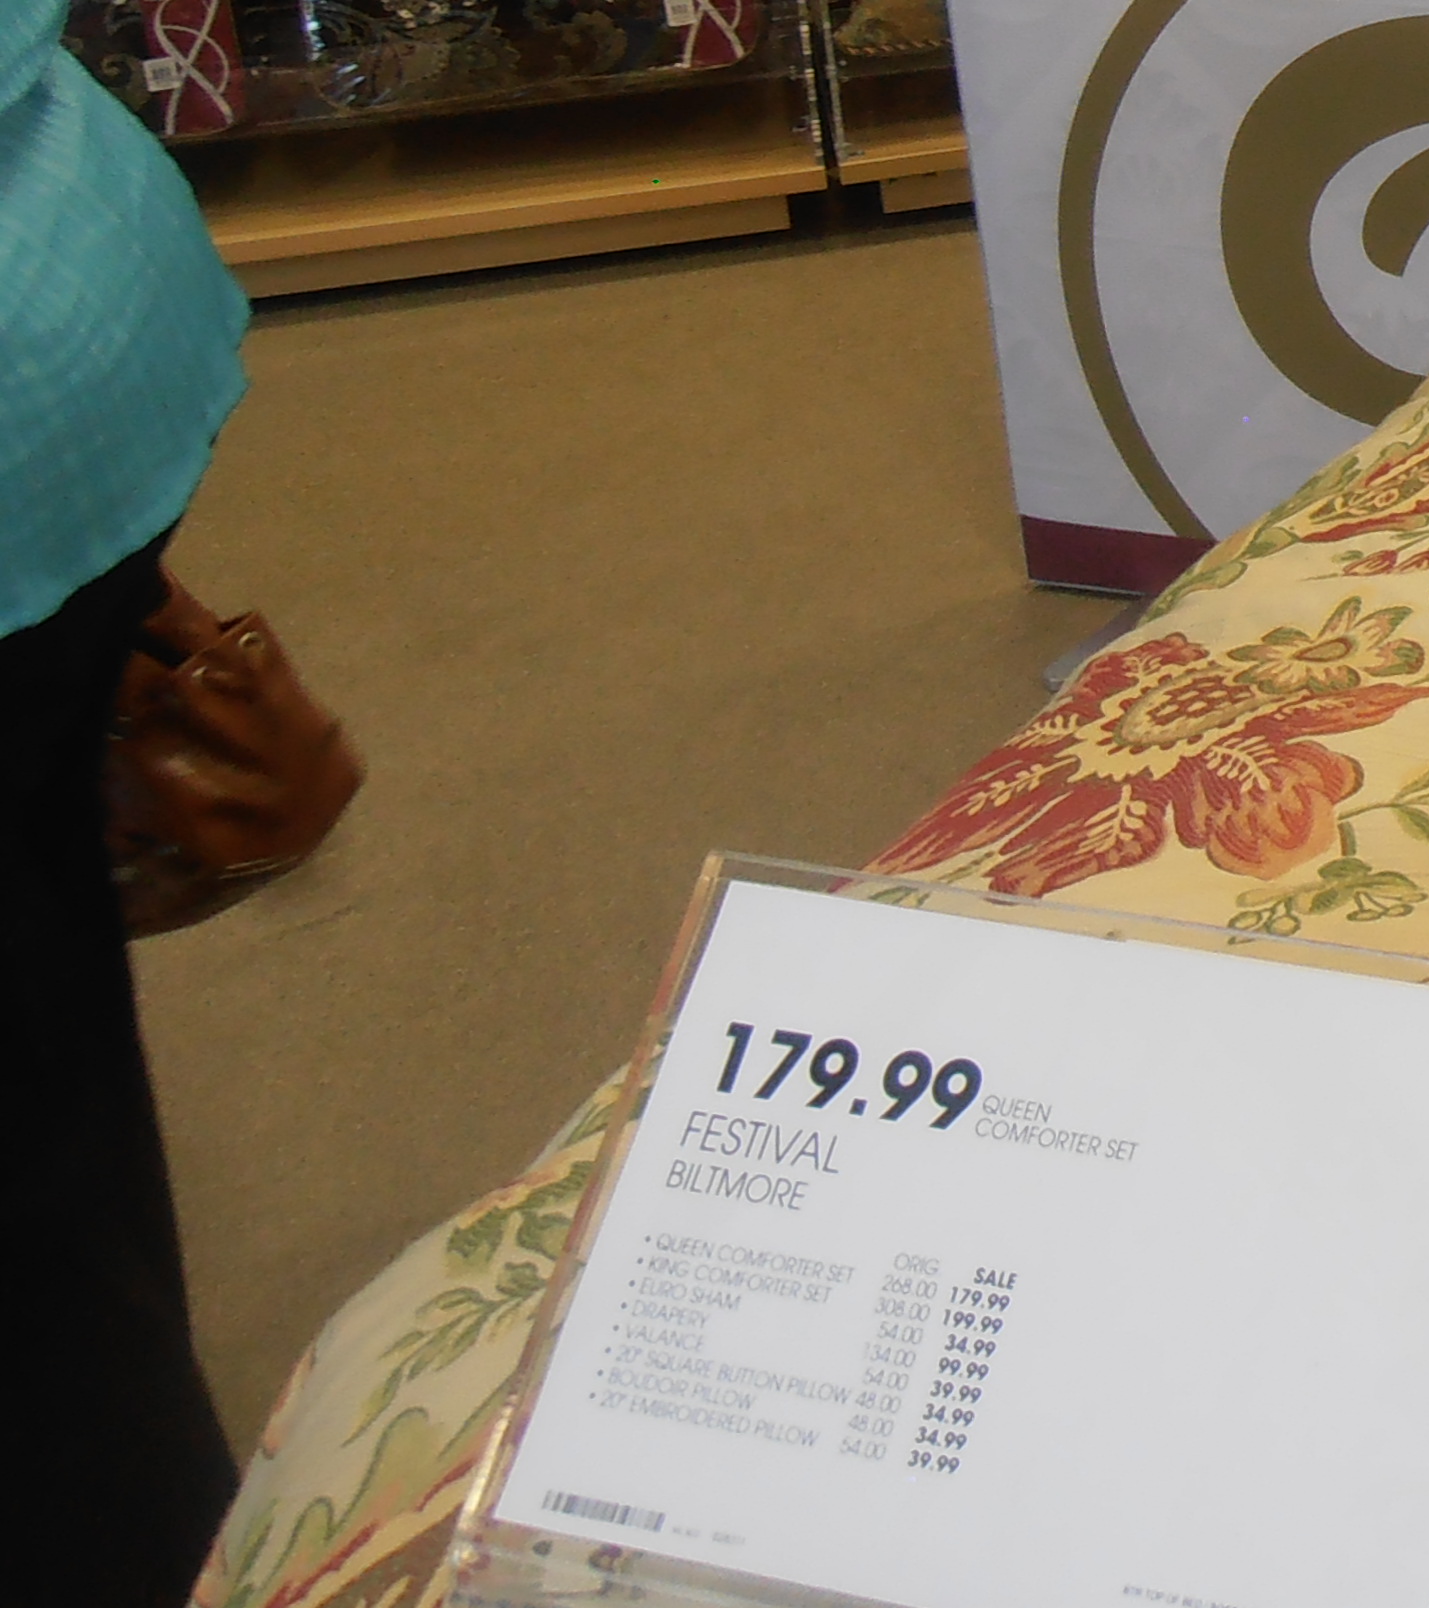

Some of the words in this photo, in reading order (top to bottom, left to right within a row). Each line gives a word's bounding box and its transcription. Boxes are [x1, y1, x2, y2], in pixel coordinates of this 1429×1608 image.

[715, 1020, 984, 1131] 179.99
[981, 1093, 1054, 1124] QUEEN
[680, 1109, 842, 1175] FESTIVAL
[974, 1118, 1104, 1158] COMFORTER
[1103, 1138, 1141, 1165] SET
[664, 1159, 811, 1212] BILTMORE
[647, 1255, 692, 1279] KING
[694, 1264, 803, 1300] COMFORTER
[802, 1282, 834, 1305] SET
[941, 1307, 1005, 1335] 199.99
[655, 1232, 716, 1260] QUEEN
[716, 1244, 826, 1281] COMFORTER
[826, 1263, 857, 1286] SET
[949, 1285, 1012, 1313] 179.99
[893, 1252, 941, 1276] ORIG
[973, 1266, 1018, 1291] SALE
[631, 1298, 711, 1330] DRAPERY
[937, 1355, 991, 1382] 99.99
[638, 1276, 688, 1301] EURO
[689, 1285, 743, 1312] SHAM
[943, 1332, 998, 1359] 34.99
[624, 1323, 706, 1353] VALANCE
[929, 1378, 983, 1405] 39.99
[644, 1349, 716, 1381] SQUARE
[716, 1362, 785, 1393] BUTTON
[785, 1375, 853, 1406] PILLOW
[921, 1402, 976, 1428] 34.99
[607, 1366, 690, 1399] BOUDOIR
[690, 1382, 758, 1412] PILLOW
[914, 1425, 968, 1452] 34.99
[628, 1395, 752, 1435] EMBROIDERED
[753, 1417, 821, 1448] PILLOW
[906, 1448, 961, 1475] 39.99
